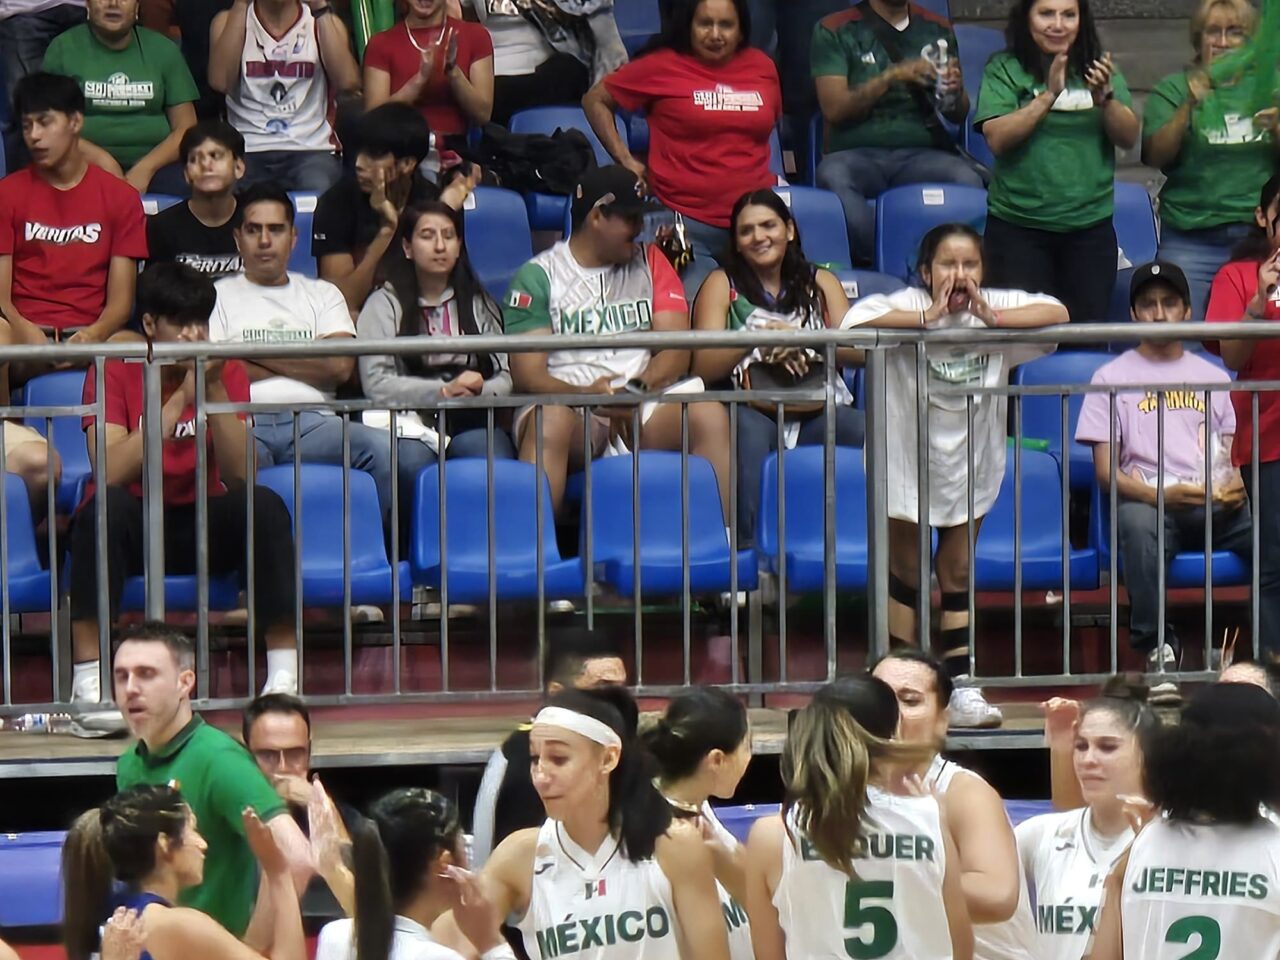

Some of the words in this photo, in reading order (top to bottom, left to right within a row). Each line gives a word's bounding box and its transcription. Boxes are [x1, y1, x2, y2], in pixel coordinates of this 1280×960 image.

[1132, 867, 1269, 900] JEFFRIES
[536, 906, 670, 960] MÉXICO
[843, 880, 898, 960] 5
